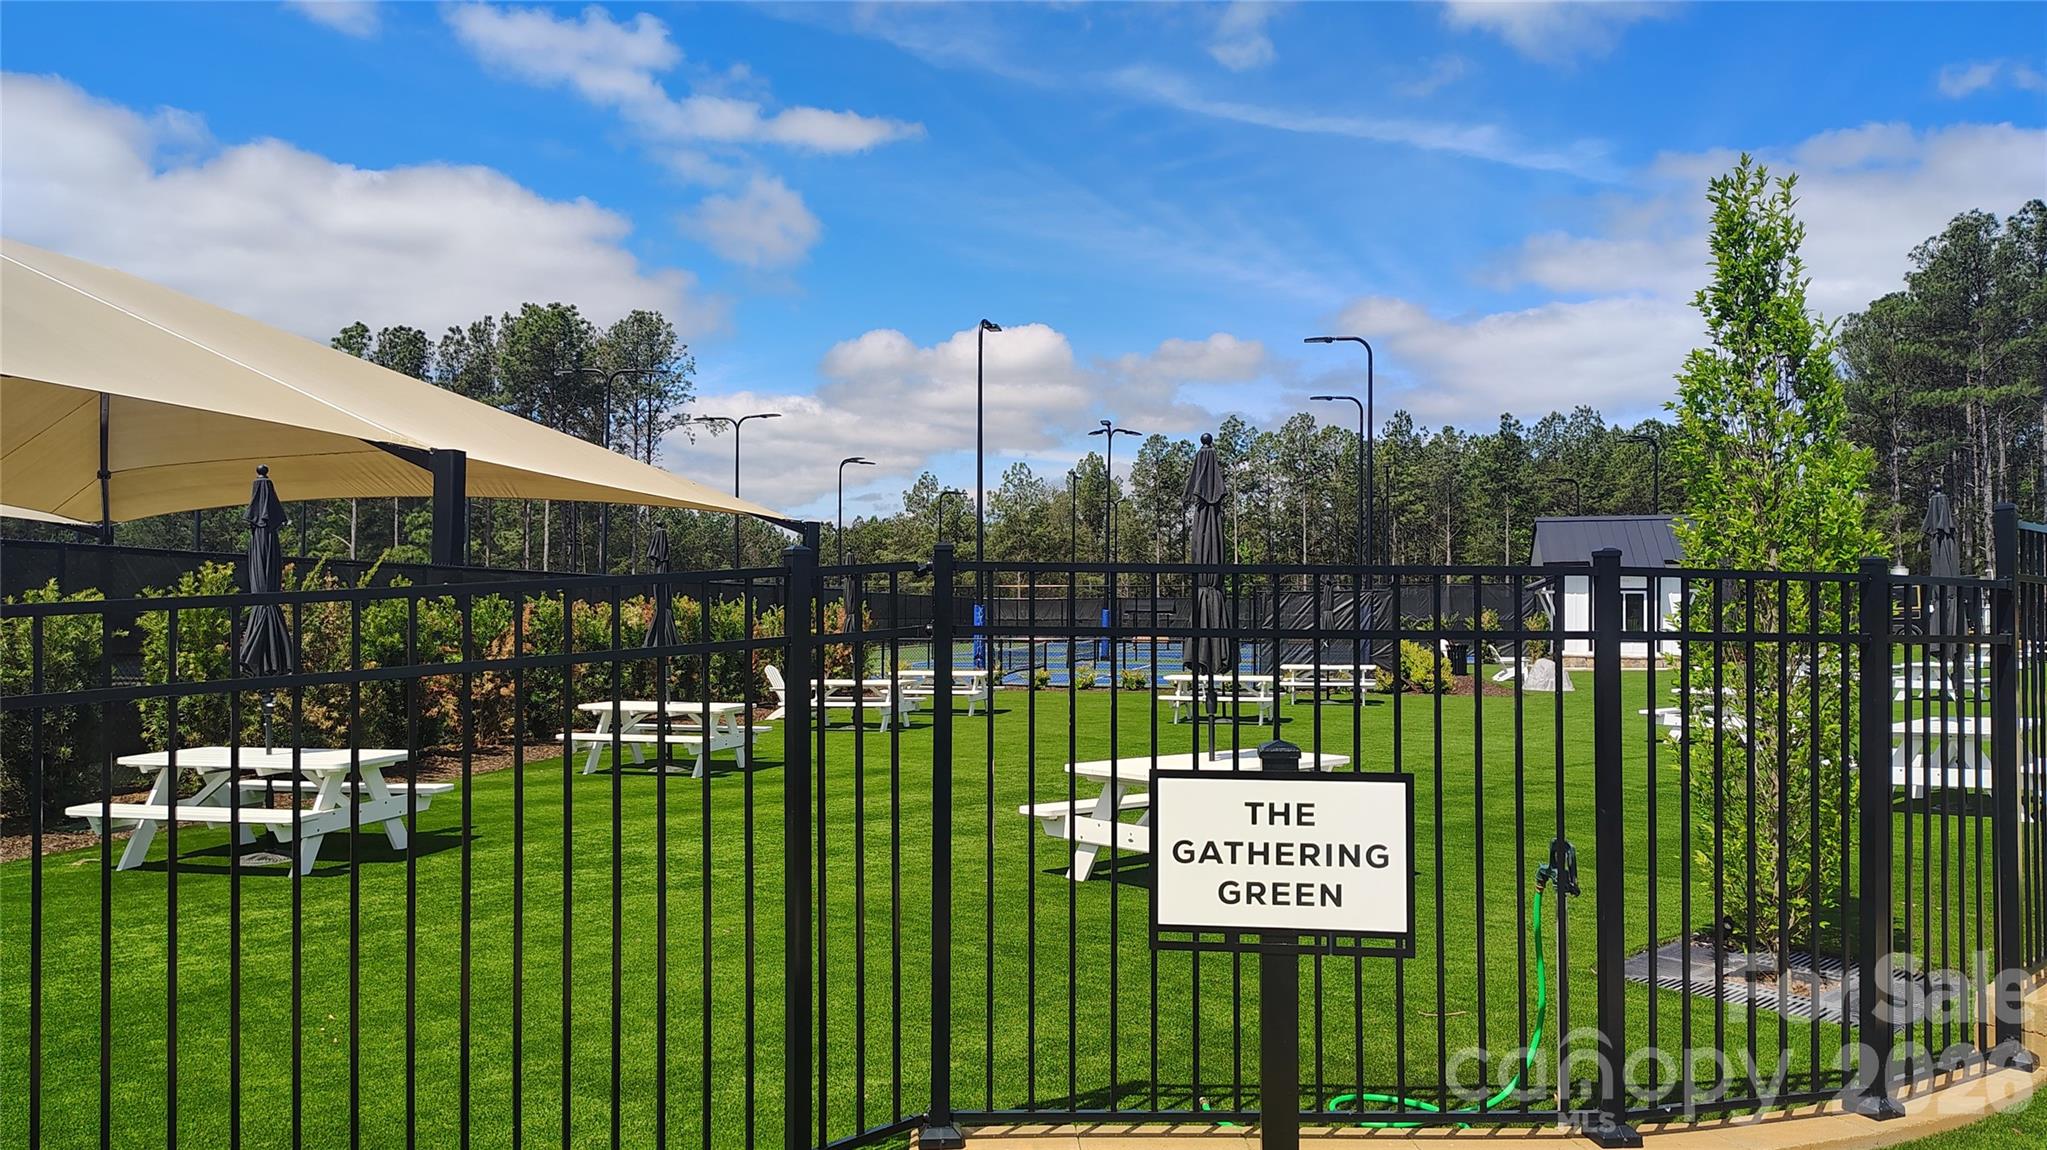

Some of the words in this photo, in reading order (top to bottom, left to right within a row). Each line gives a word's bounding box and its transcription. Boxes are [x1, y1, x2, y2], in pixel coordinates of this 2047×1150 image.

[1244, 801, 1316, 827] THE
[1172, 839, 1390, 869] GATHERING
[1218, 880, 1343, 908] GREEN
